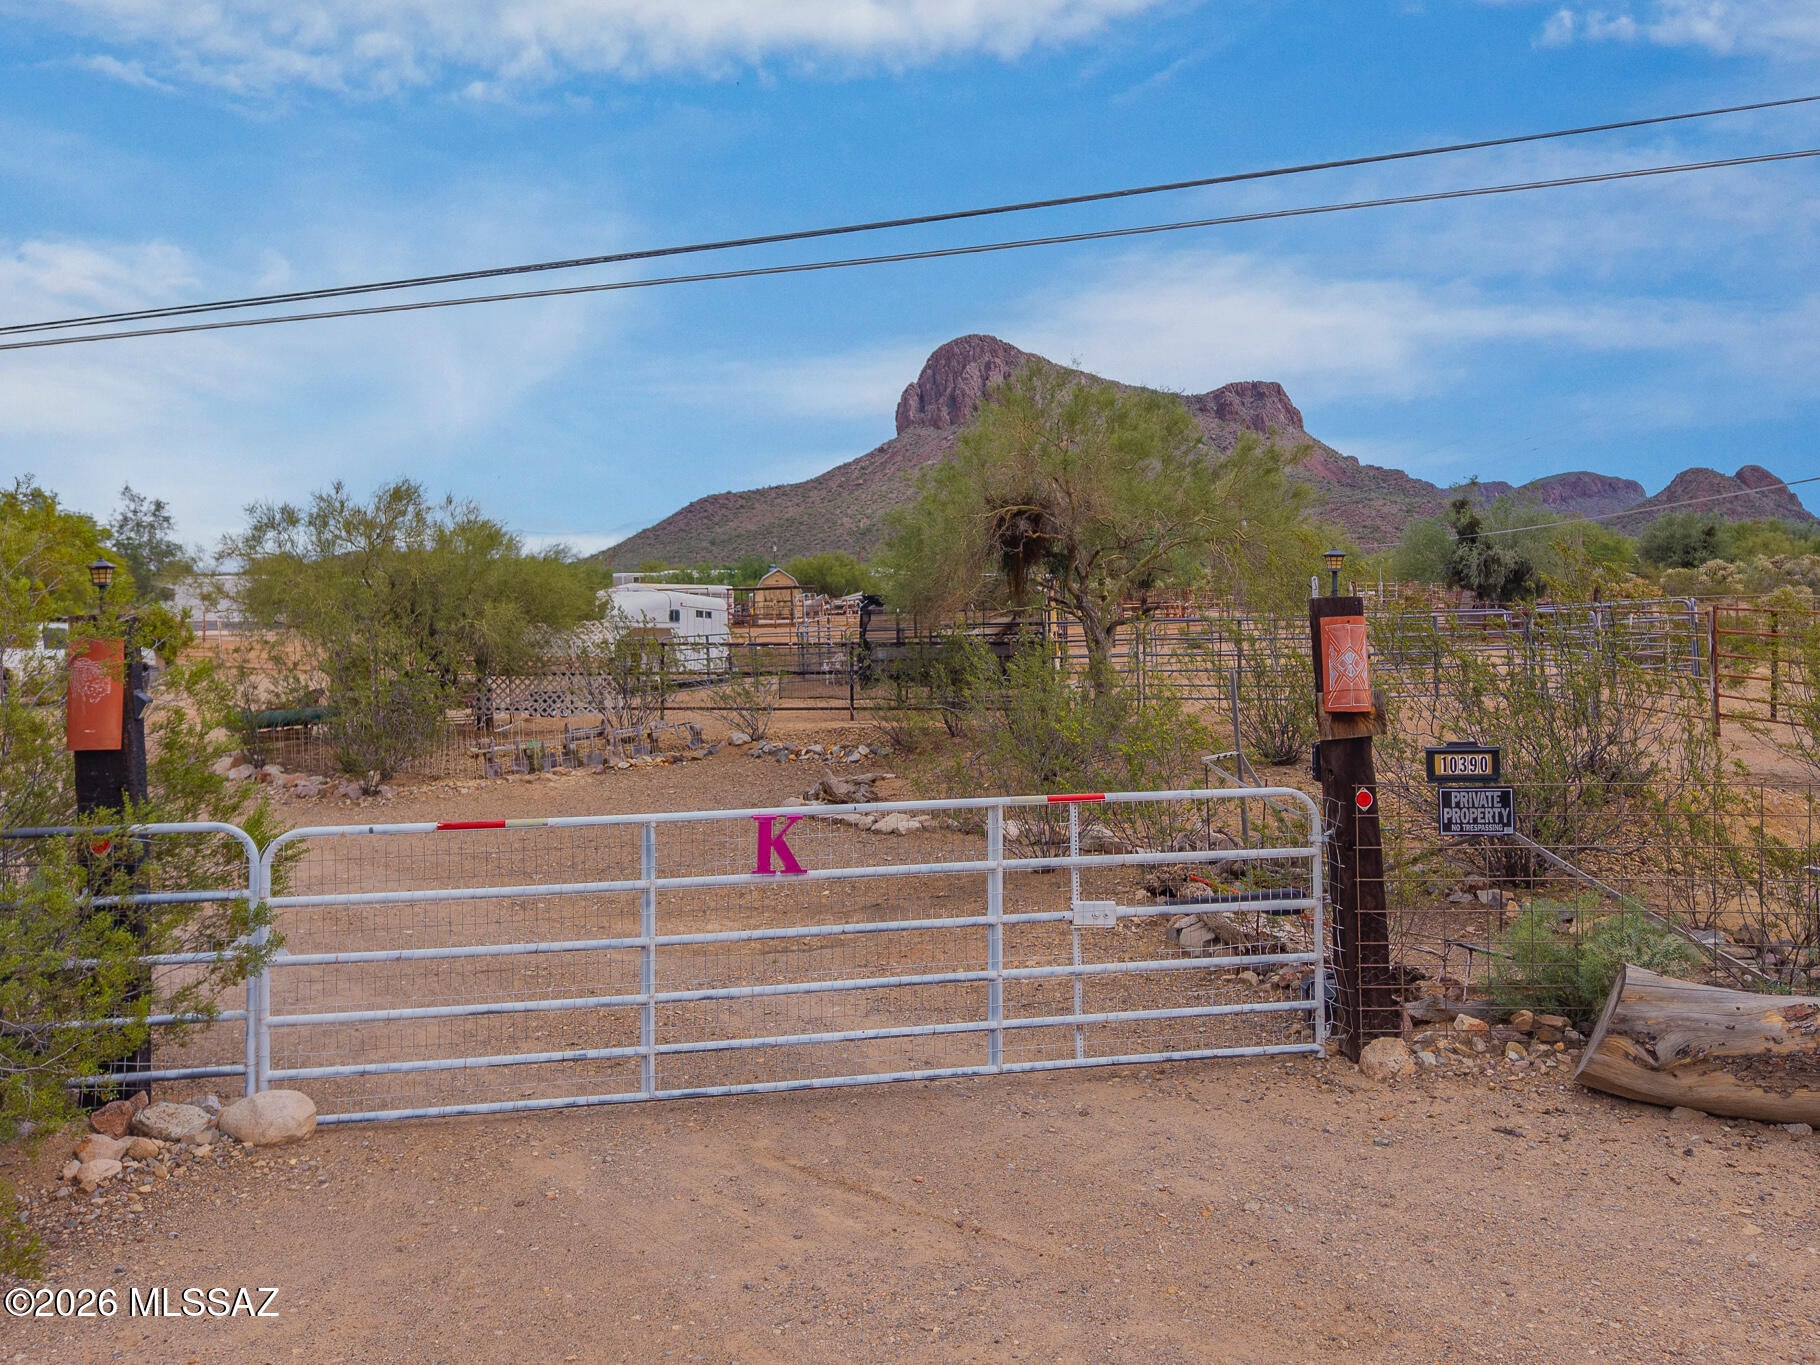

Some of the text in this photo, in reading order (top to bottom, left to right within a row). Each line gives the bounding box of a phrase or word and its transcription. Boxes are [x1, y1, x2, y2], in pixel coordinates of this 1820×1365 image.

[1441, 756, 1488, 773] 10390
[1451, 792, 1501, 807] PRIVATE
[1443, 808, 1509, 823] PROPERTY
[751, 815, 808, 874] K
